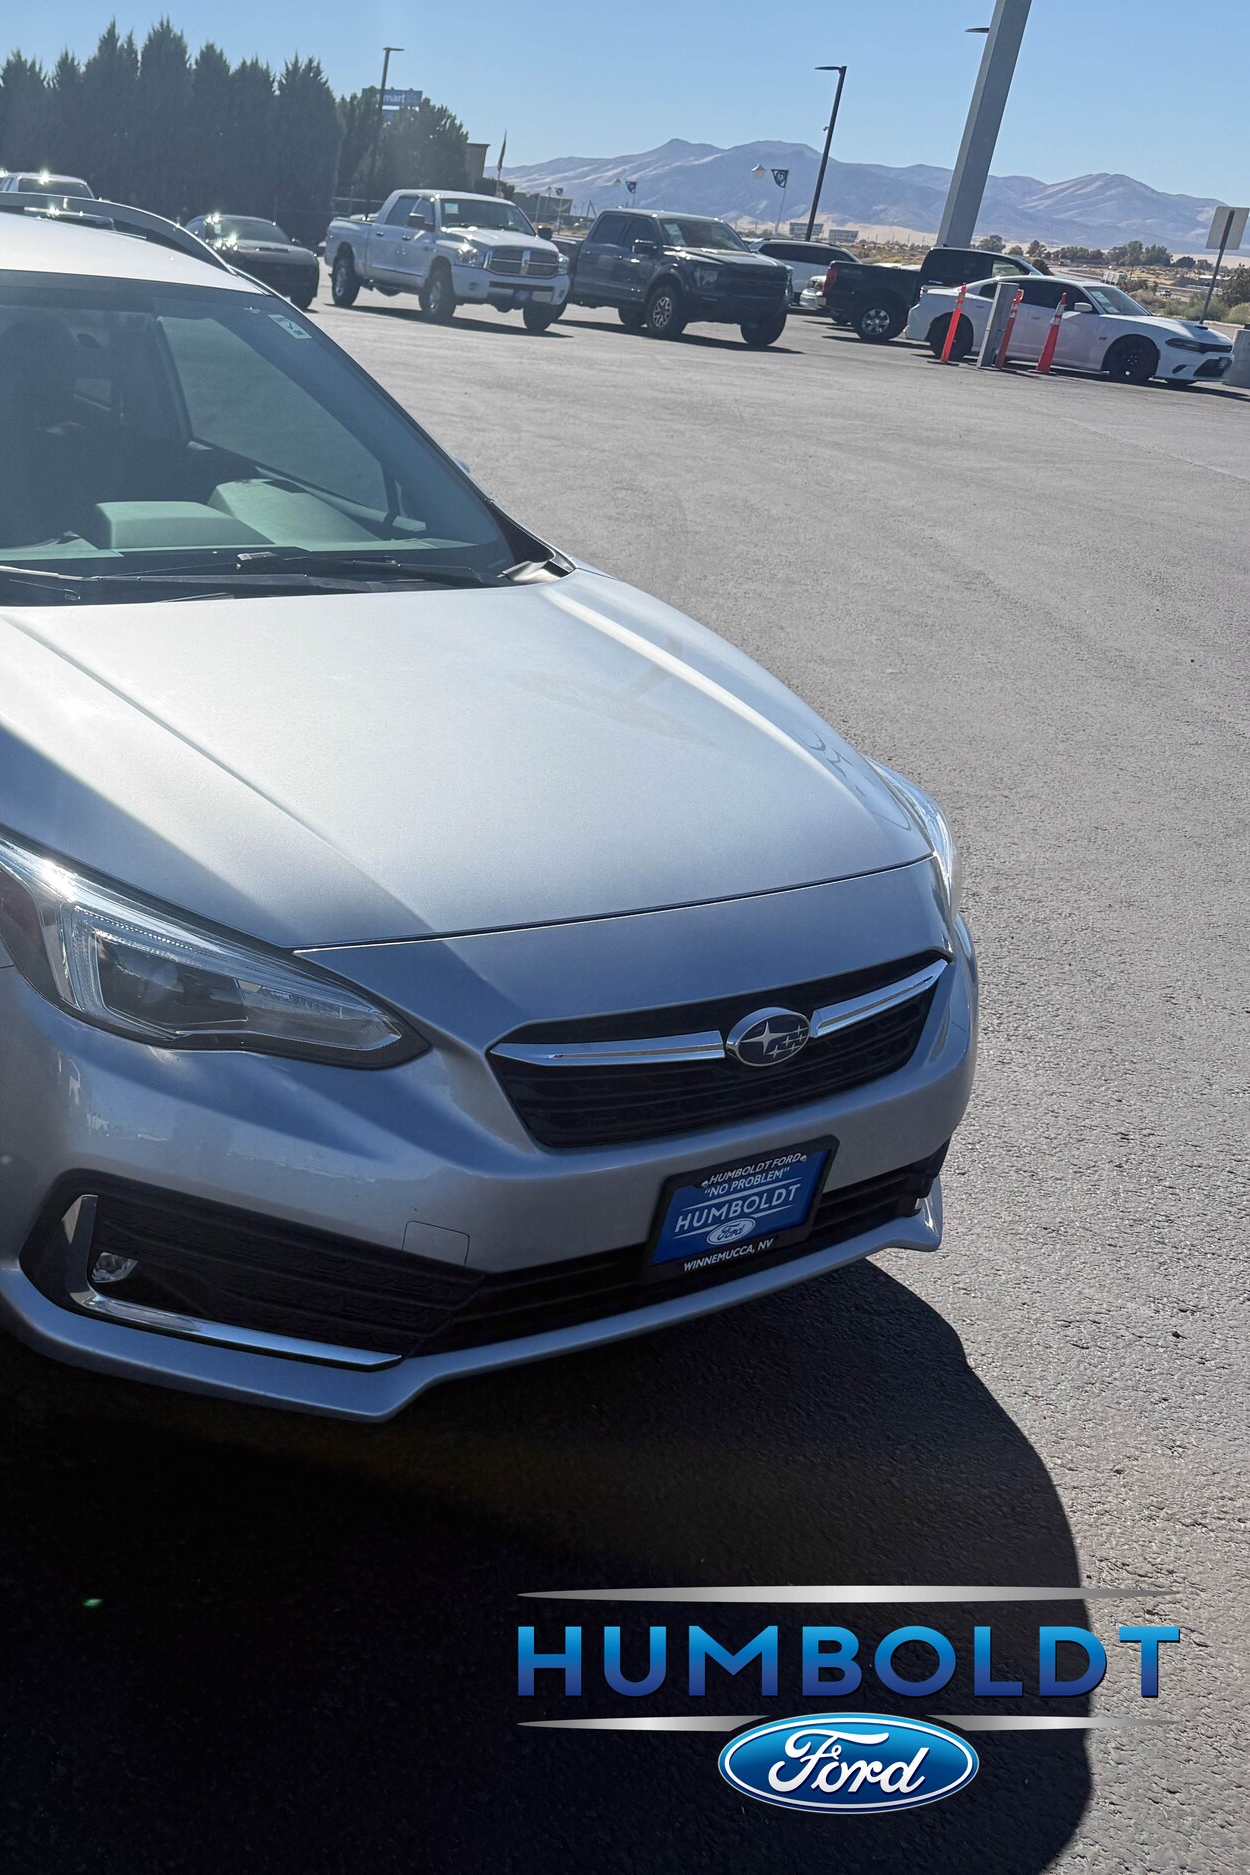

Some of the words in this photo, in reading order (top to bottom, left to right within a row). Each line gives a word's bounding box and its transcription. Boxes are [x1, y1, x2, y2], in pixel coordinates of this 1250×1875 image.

[708, 1160, 772, 1184] HUMBOLDT
[771, 1153, 801, 1169] FORD
[675, 1184, 801, 1233] HUMBOLDT
[716, 1221, 746, 1241] Ford
[684, 1246, 756, 1271] WINNEMUCCA,
[758, 1238, 775, 1251] NV
